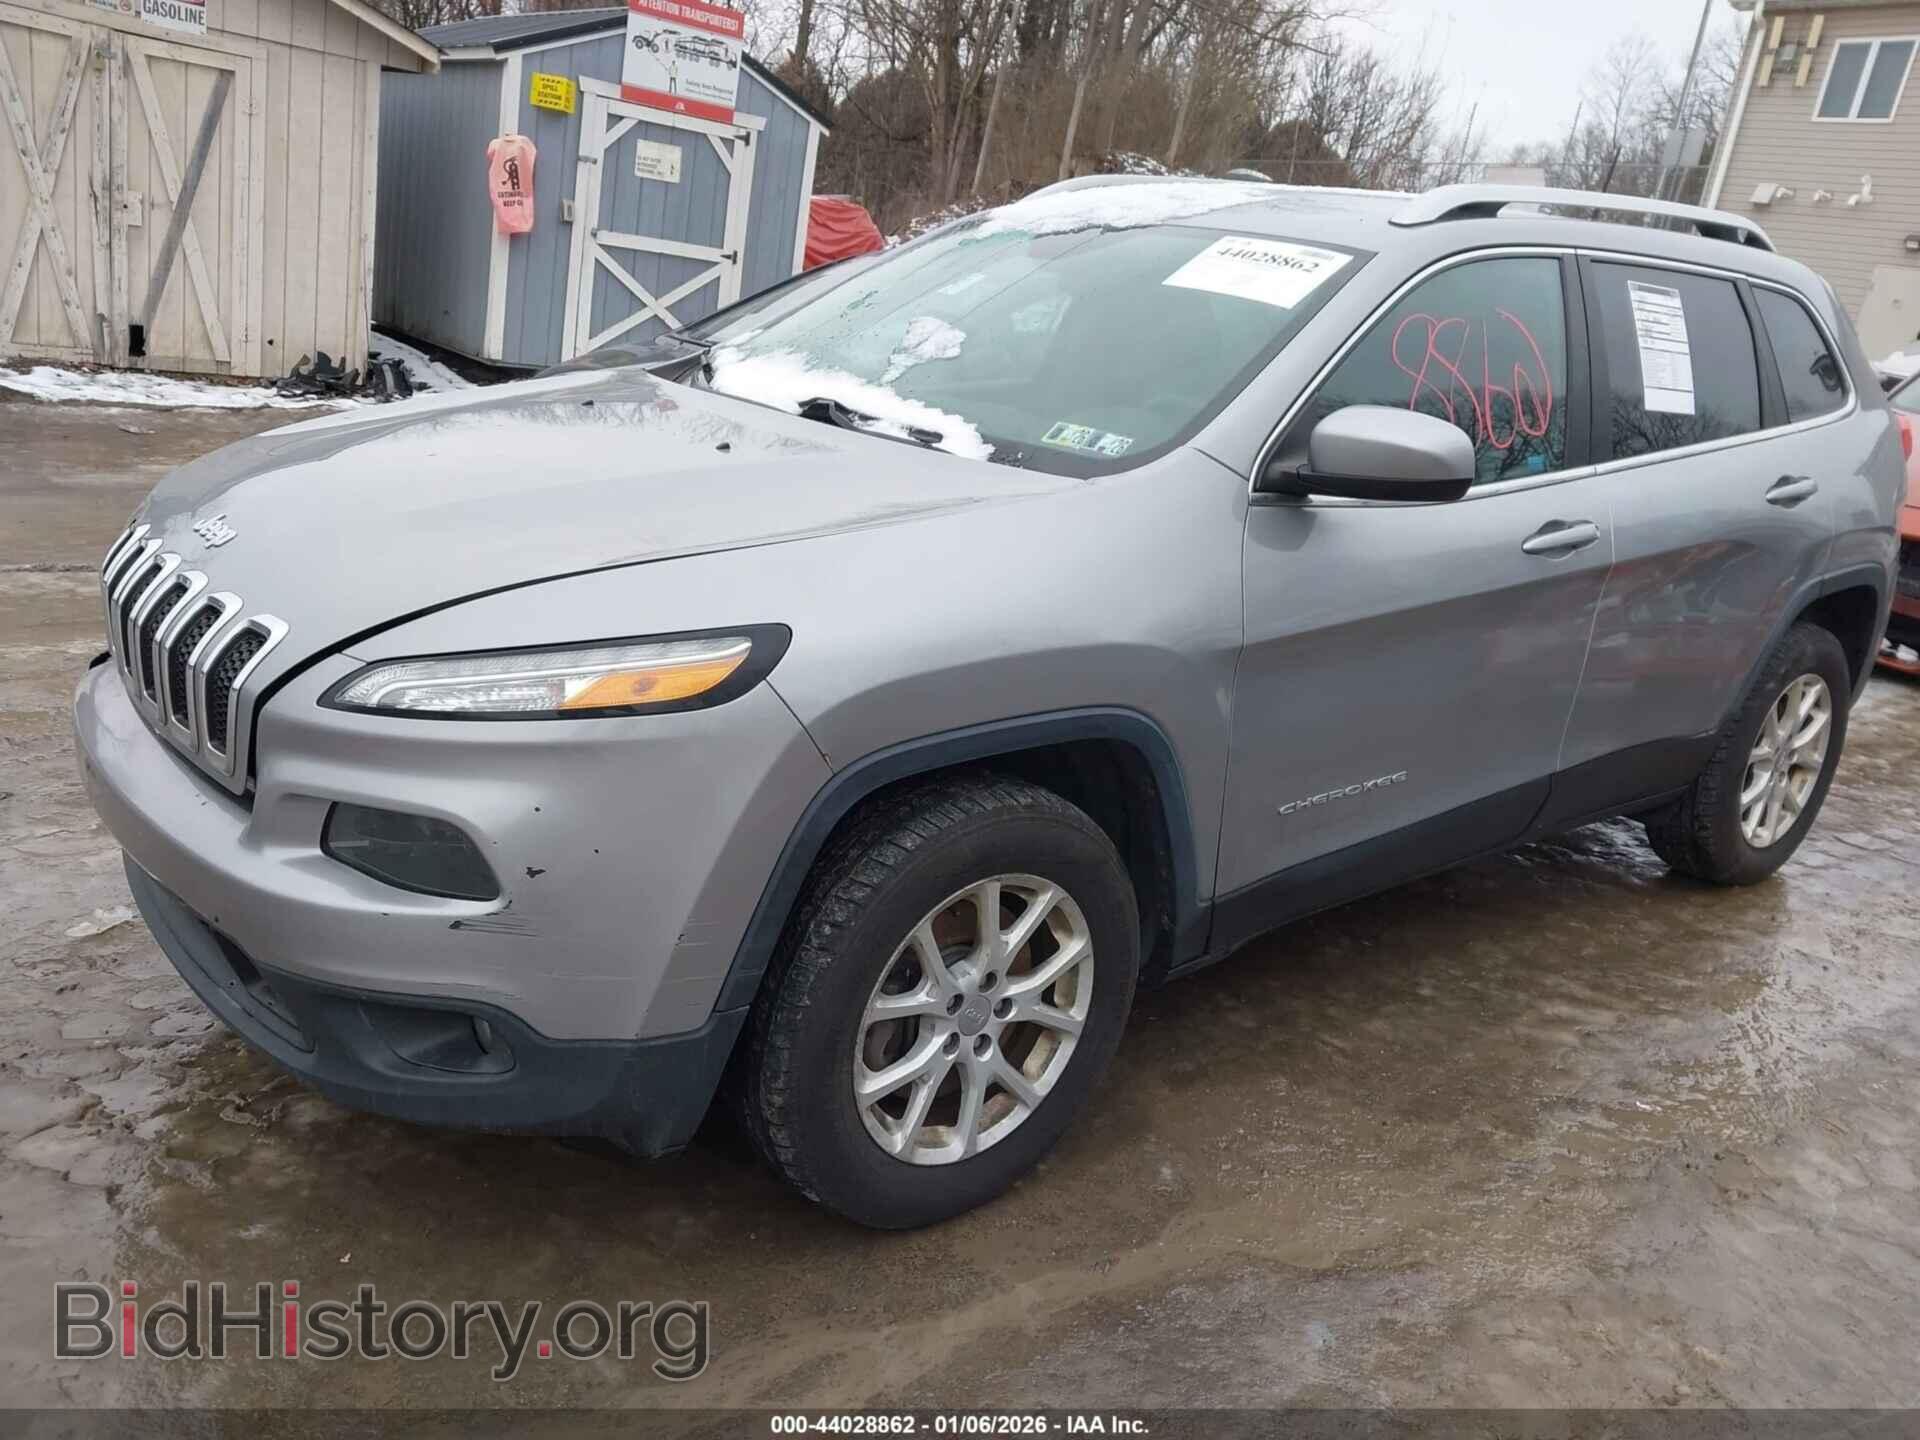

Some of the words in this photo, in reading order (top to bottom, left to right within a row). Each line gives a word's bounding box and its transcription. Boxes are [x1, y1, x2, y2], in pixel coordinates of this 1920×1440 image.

[143, 0, 205, 26] GASOLINE
[638, 0, 680, 16] ATTENTION
[681, 5, 739, 31] TRANSPORTERS!
[1216, 246, 1320, 273] 44028862
[193, 513, 238, 549] Jeep
[1278, 770, 1408, 816] CHEROKEE
